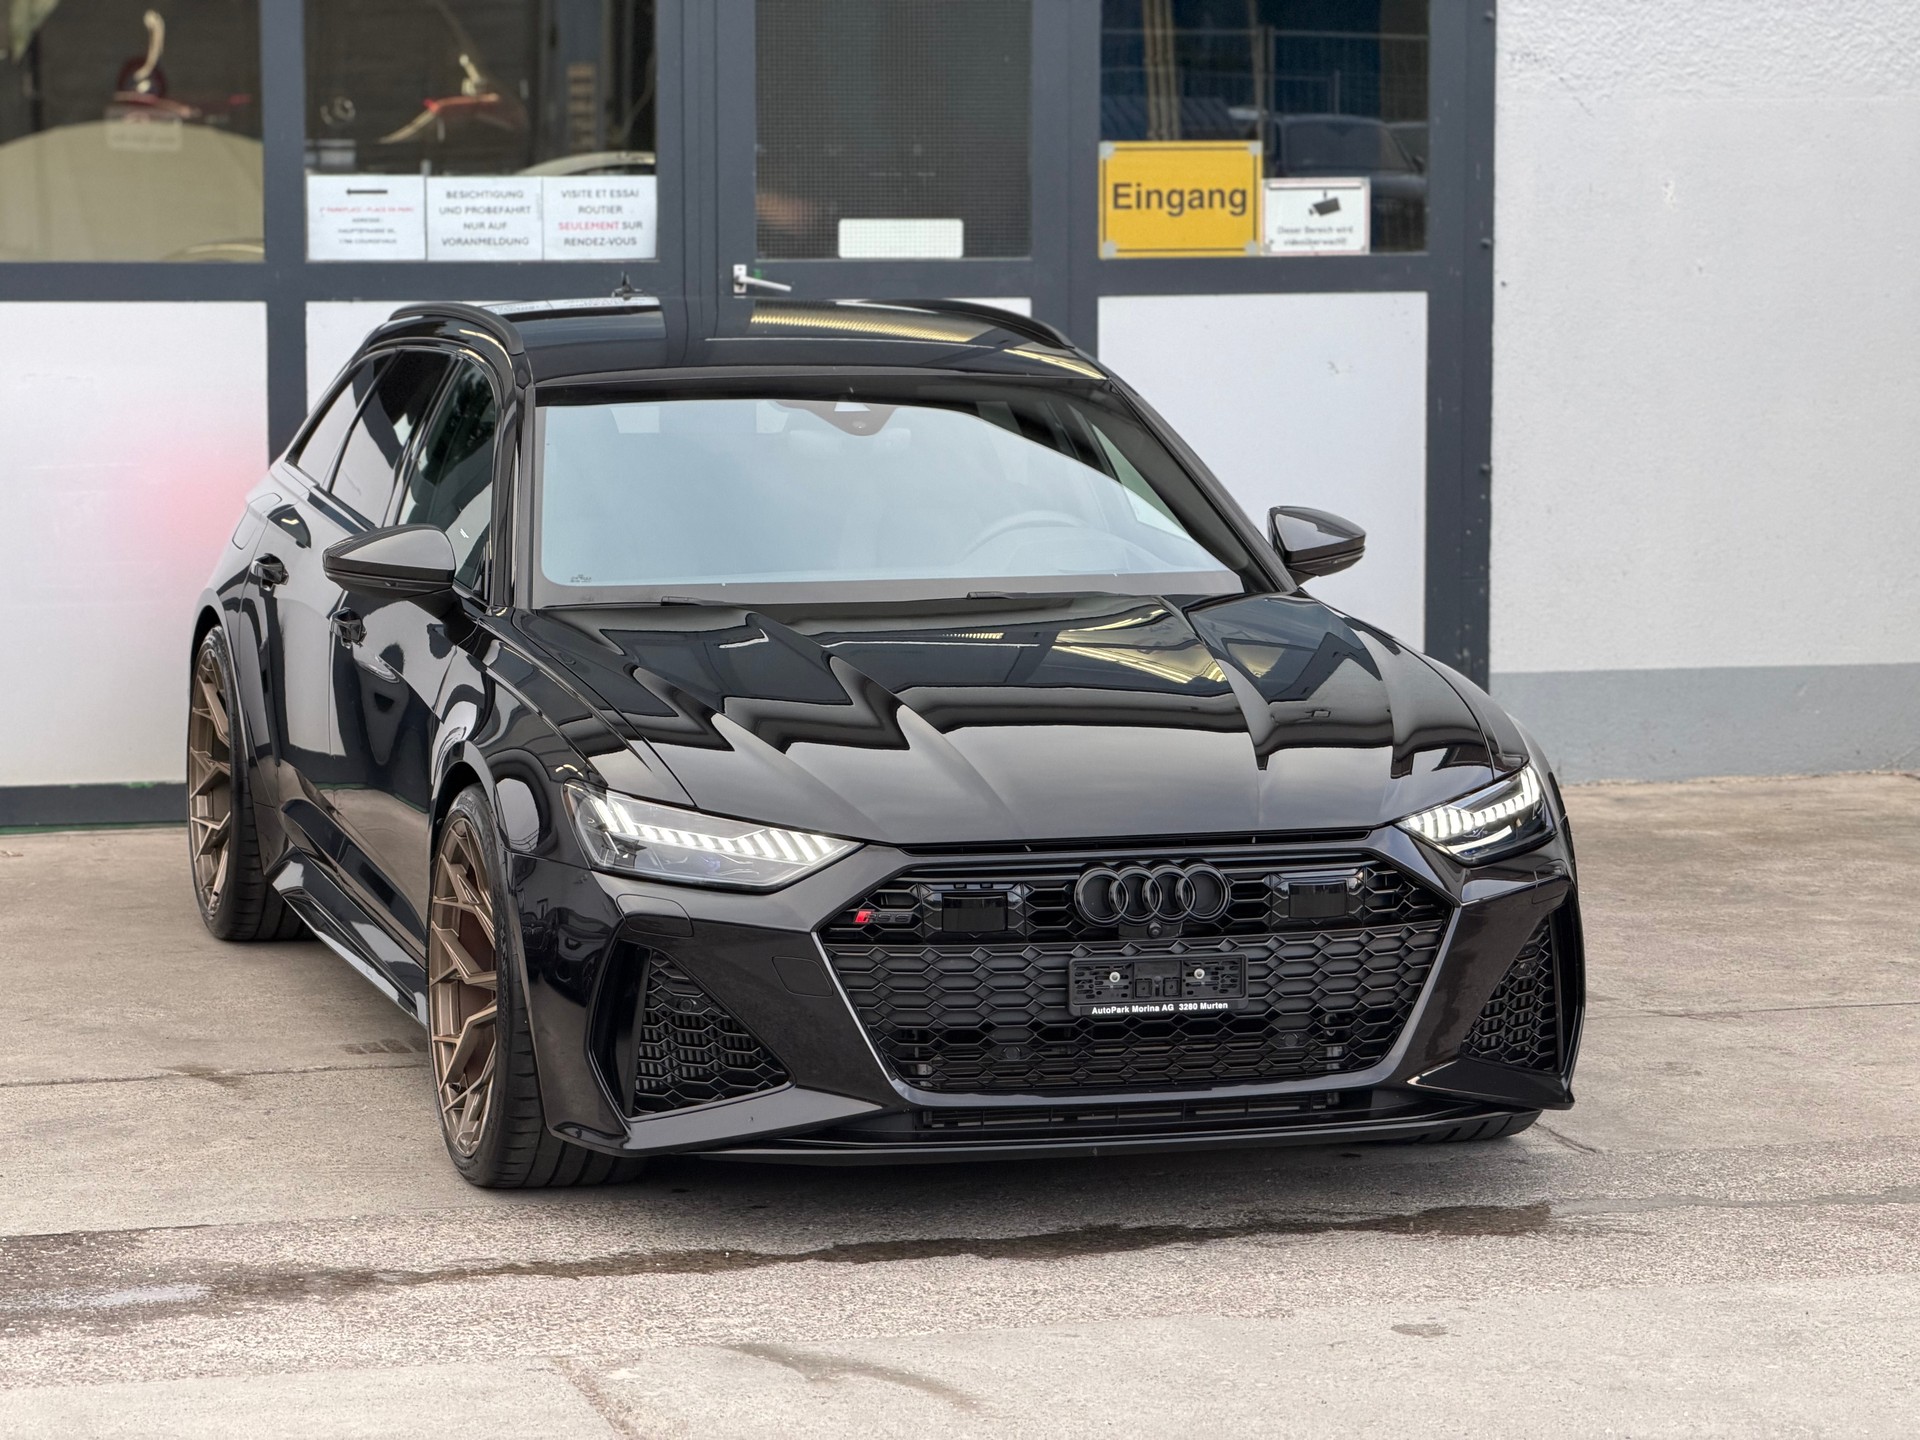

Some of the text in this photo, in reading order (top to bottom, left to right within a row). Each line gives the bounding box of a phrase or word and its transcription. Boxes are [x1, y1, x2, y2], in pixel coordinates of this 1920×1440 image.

[445, 190, 524, 199] BESICHTIGUNG
[561, 189, 639, 198] VISITE ET ESSAI
[1112, 182, 1248, 217] Eingang
[439, 206, 531, 214] UND PROBEFAHRT
[578, 205, 622, 214] ROUTIER
[463, 221, 507, 230] NUR AUF
[558, 221, 643, 230] SEULEMENT SUR
[441, 237, 529, 246] VORANMELDUNG
[564, 237, 637, 246] RENDEZ-VOUS
[1091, 1001, 1229, 1015] AutoPark Morina AG 3280 Murten
